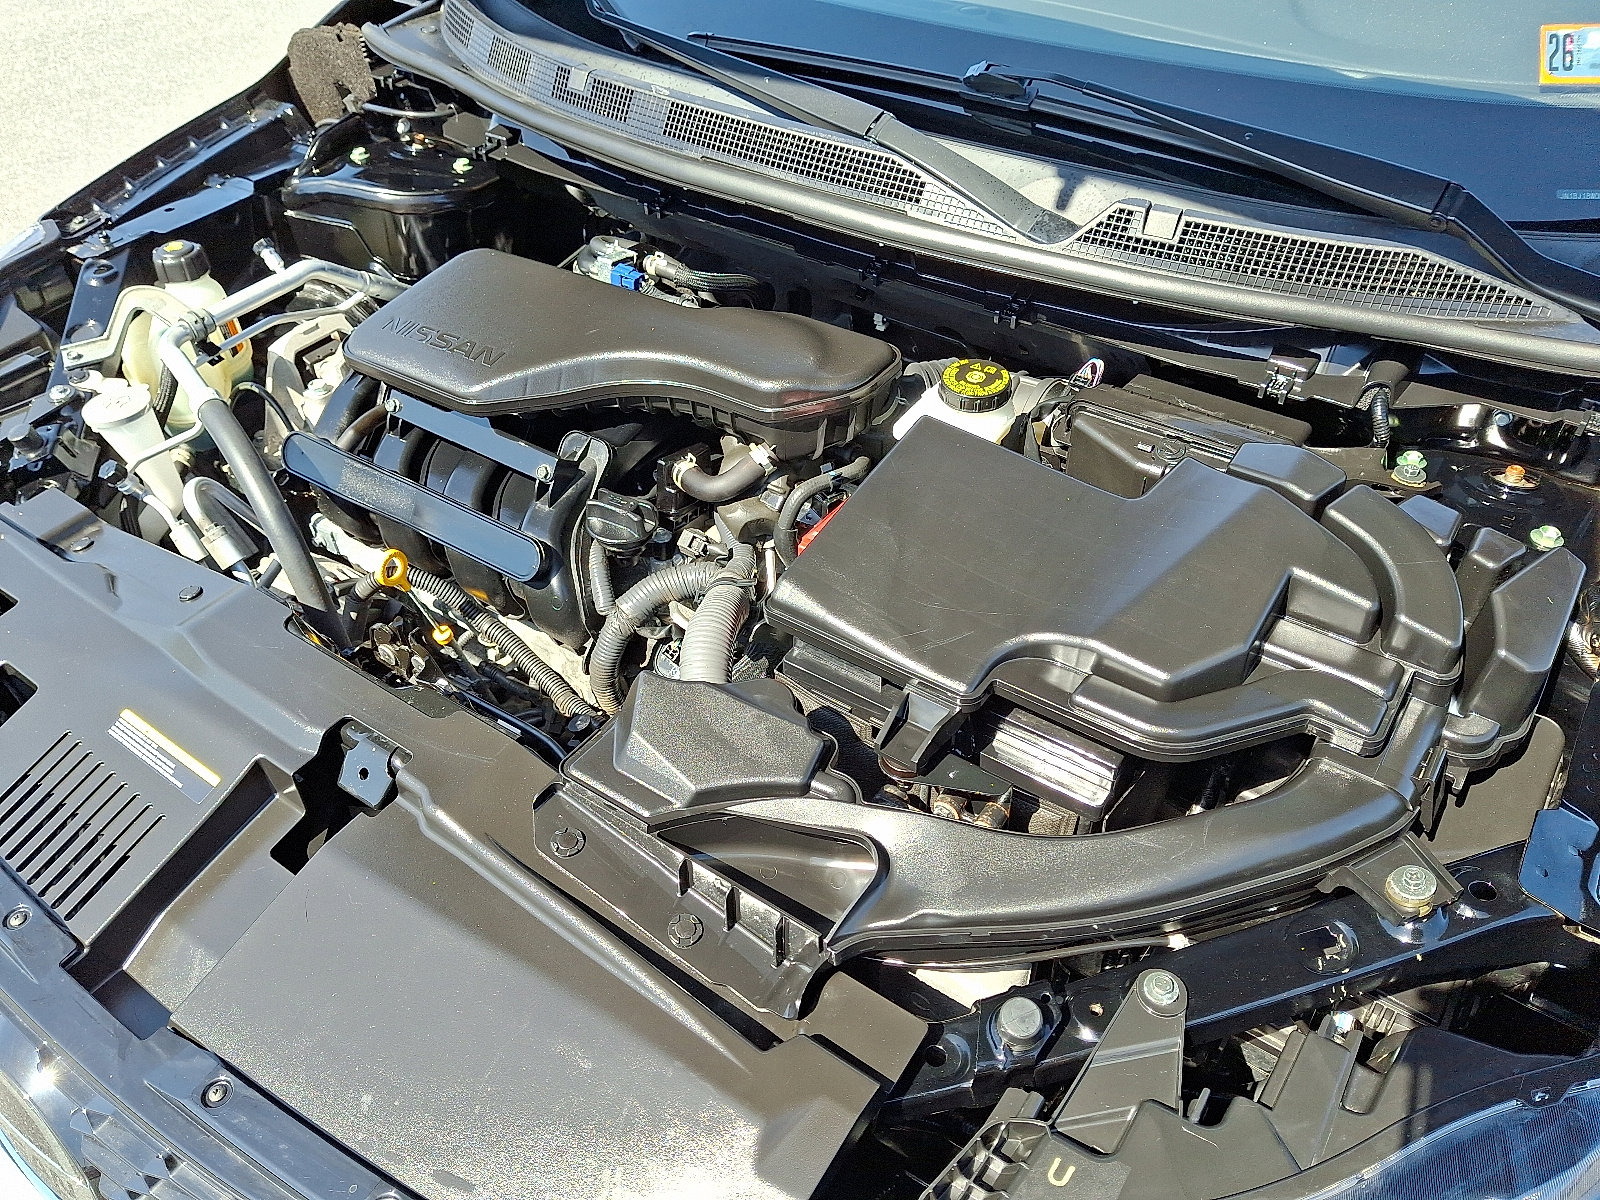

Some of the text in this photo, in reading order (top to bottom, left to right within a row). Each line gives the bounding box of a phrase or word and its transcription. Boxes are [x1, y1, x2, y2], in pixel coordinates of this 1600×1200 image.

[1548, 33, 1574, 72] 26
[381, 317, 506, 368] NISSAN
[1047, 1157, 1076, 1187] U
